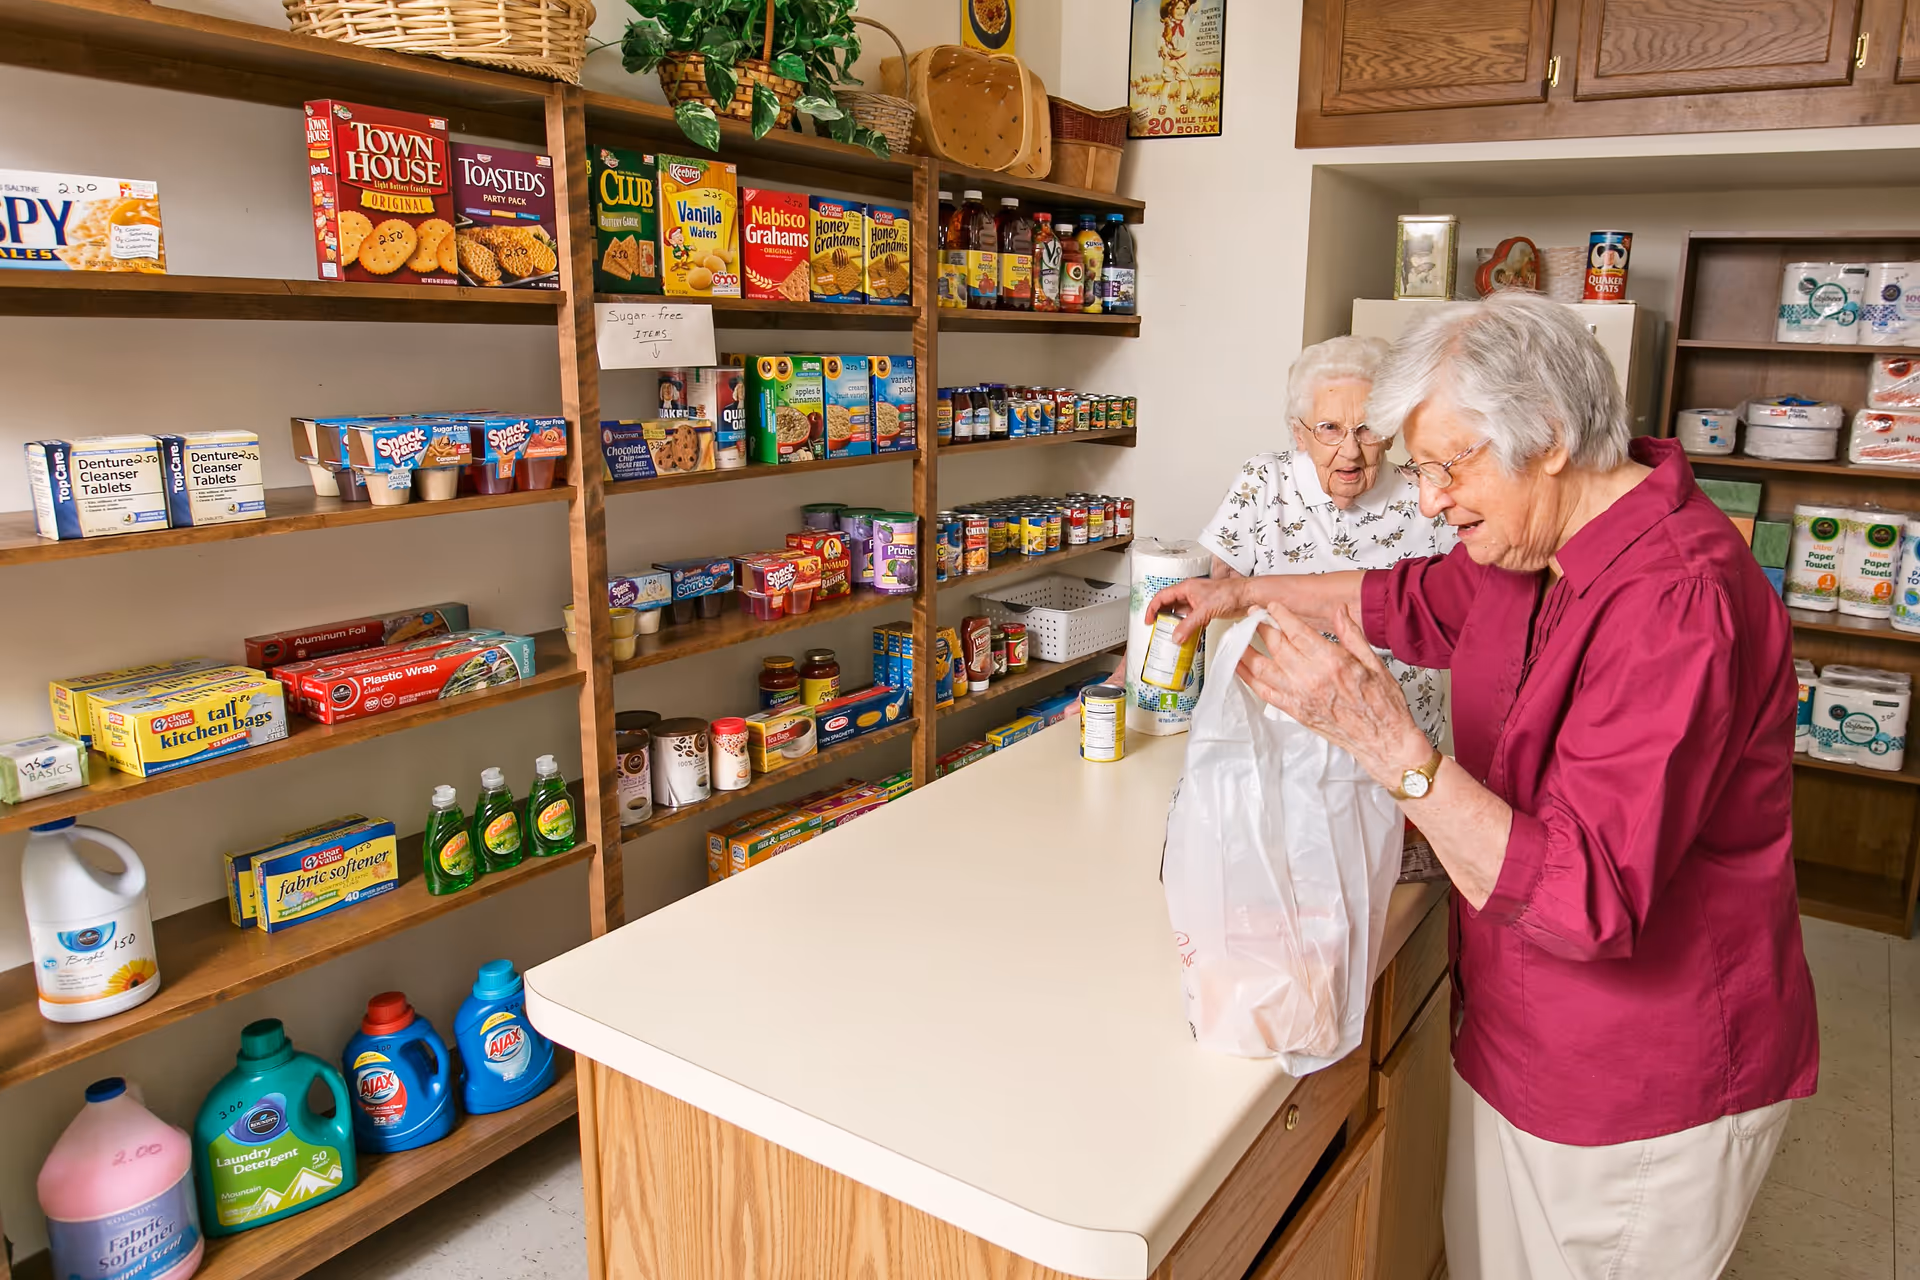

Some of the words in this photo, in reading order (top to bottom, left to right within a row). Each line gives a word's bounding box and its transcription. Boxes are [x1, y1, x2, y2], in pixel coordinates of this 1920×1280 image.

[307, 117, 328, 131] TOWN
[1147, 117, 1175, 135] 20
[1175, 116, 1196, 124] MULE
[1198, 115, 1218, 123] TEAM
[1176, 124, 1216, 134] BORAX
[307, 129, 330, 144] HOUSE
[350, 121, 433, 160] TOWN
[346, 151, 443, 186] HOUSE
[670, 163, 700, 180] Keebler
[458, 157, 546, 197] TOASTEDS
[5, 184, 40, 194] SALTINE
[58, 182, 98, 195] 2.00
[374, 180, 389, 190] Light
[410, 184, 432, 194] Crackers
[600, 168, 655, 208] CLUB
[371, 194, 425, 212] ORIGINAL
[483, 194, 506, 204] PARTY
[508, 196, 527, 206] PACK
[677, 200, 722, 226] Vanilla
[751, 205, 806, 229] Nabisco
[600, 214, 622, 227] BUTTERY
[689, 226, 718, 240] Wafers
[815, 219, 850, 237] Honey
[870, 227, 900, 243] Honey
[745, 224, 809, 248] Grahams
[814, 233, 861, 255] Grahams
[869, 239, 909, 260] Grahams
[763, 247, 794, 256] ORIGINAL
[1588, 275, 1624, 286] QUAKER
[1594, 283, 1619, 293] OATS
[633, 330, 668, 340] ITEMS
[890, 376, 914, 385] variety
[795, 388, 816, 397] apples
[899, 386, 914, 395] pack
[789, 396, 821, 404] cinnamon
[432, 426, 453, 434] Sugar
[453, 424, 468, 432] Free
[487, 420, 530, 447] Snack
[376, 427, 427, 457] Snack
[191, 451, 239, 462] Denture
[606, 445, 647, 457] Chocolate
[78, 458, 134, 470] Denture
[615, 462, 633, 470] SUGAR
[618, 455, 635, 463] Chip
[80, 470, 139, 482] Cleanser
[170, 445, 185, 494] TopCare
[192, 463, 243, 475] Cleanser
[54, 451, 71, 504] TopCare
[193, 474, 237, 486] Tablets
[81, 483, 132, 495] Tablets
[1808, 551, 1835, 562] Paper
[1864, 558, 1891, 569] Paper
[1804, 560, 1836, 570] Towels
[766, 563, 796, 585] Snack
[1860, 567, 1892, 578] Towels
[677, 576, 714, 598] Snacks
[821, 572, 845, 589] RAISINS
[1825, 575, 1832, 585] 1
[1881, 583, 1888, 593] 1
[294, 630, 346, 646] Aluminum
[348, 626, 366, 636] Foil
[521, 643, 529, 675] Storage
[362, 670, 403, 687] Plastic
[405, 664, 437, 677] Wrap
[363, 684, 385, 695] clear
[937, 690, 948, 700] love
[1165, 694, 1173, 705] 1
[167, 711, 190, 722] clear
[207, 700, 236, 722] tall
[168, 718, 193, 728] value
[160, 722, 229, 750] kitchen
[233, 711, 273, 731] bags
[766, 734, 777, 744] Tea
[777, 731, 790, 741] Bags
[831, 728, 855, 740] SPAGHETTI
[221, 731, 247, 745] GALLON
[28, 763, 73, 783] BASICS
[318, 847, 341, 860] clear
[318, 853, 343, 865] value
[276, 870, 327, 902] fabric
[329, 850, 389, 880] softener
[345, 890, 360, 902] 40
[360, 888, 375, 898] DRYER
[375, 882, 394, 892] SHEETS
[488, 1025, 521, 1059] AJAX
[360, 1071, 395, 1099] AJAX
[112, 1143, 163, 1166] 2.00
[216, 1147, 271, 1168] Laundry
[312, 1150, 327, 1165] 50
[233, 1148, 299, 1176] Detergent
[221, 1185, 262, 1201] Mountain
[109, 1215, 164, 1253] Fabric
[98, 1220, 176, 1272] Softener
[150, 1232, 184, 1263] Scent
